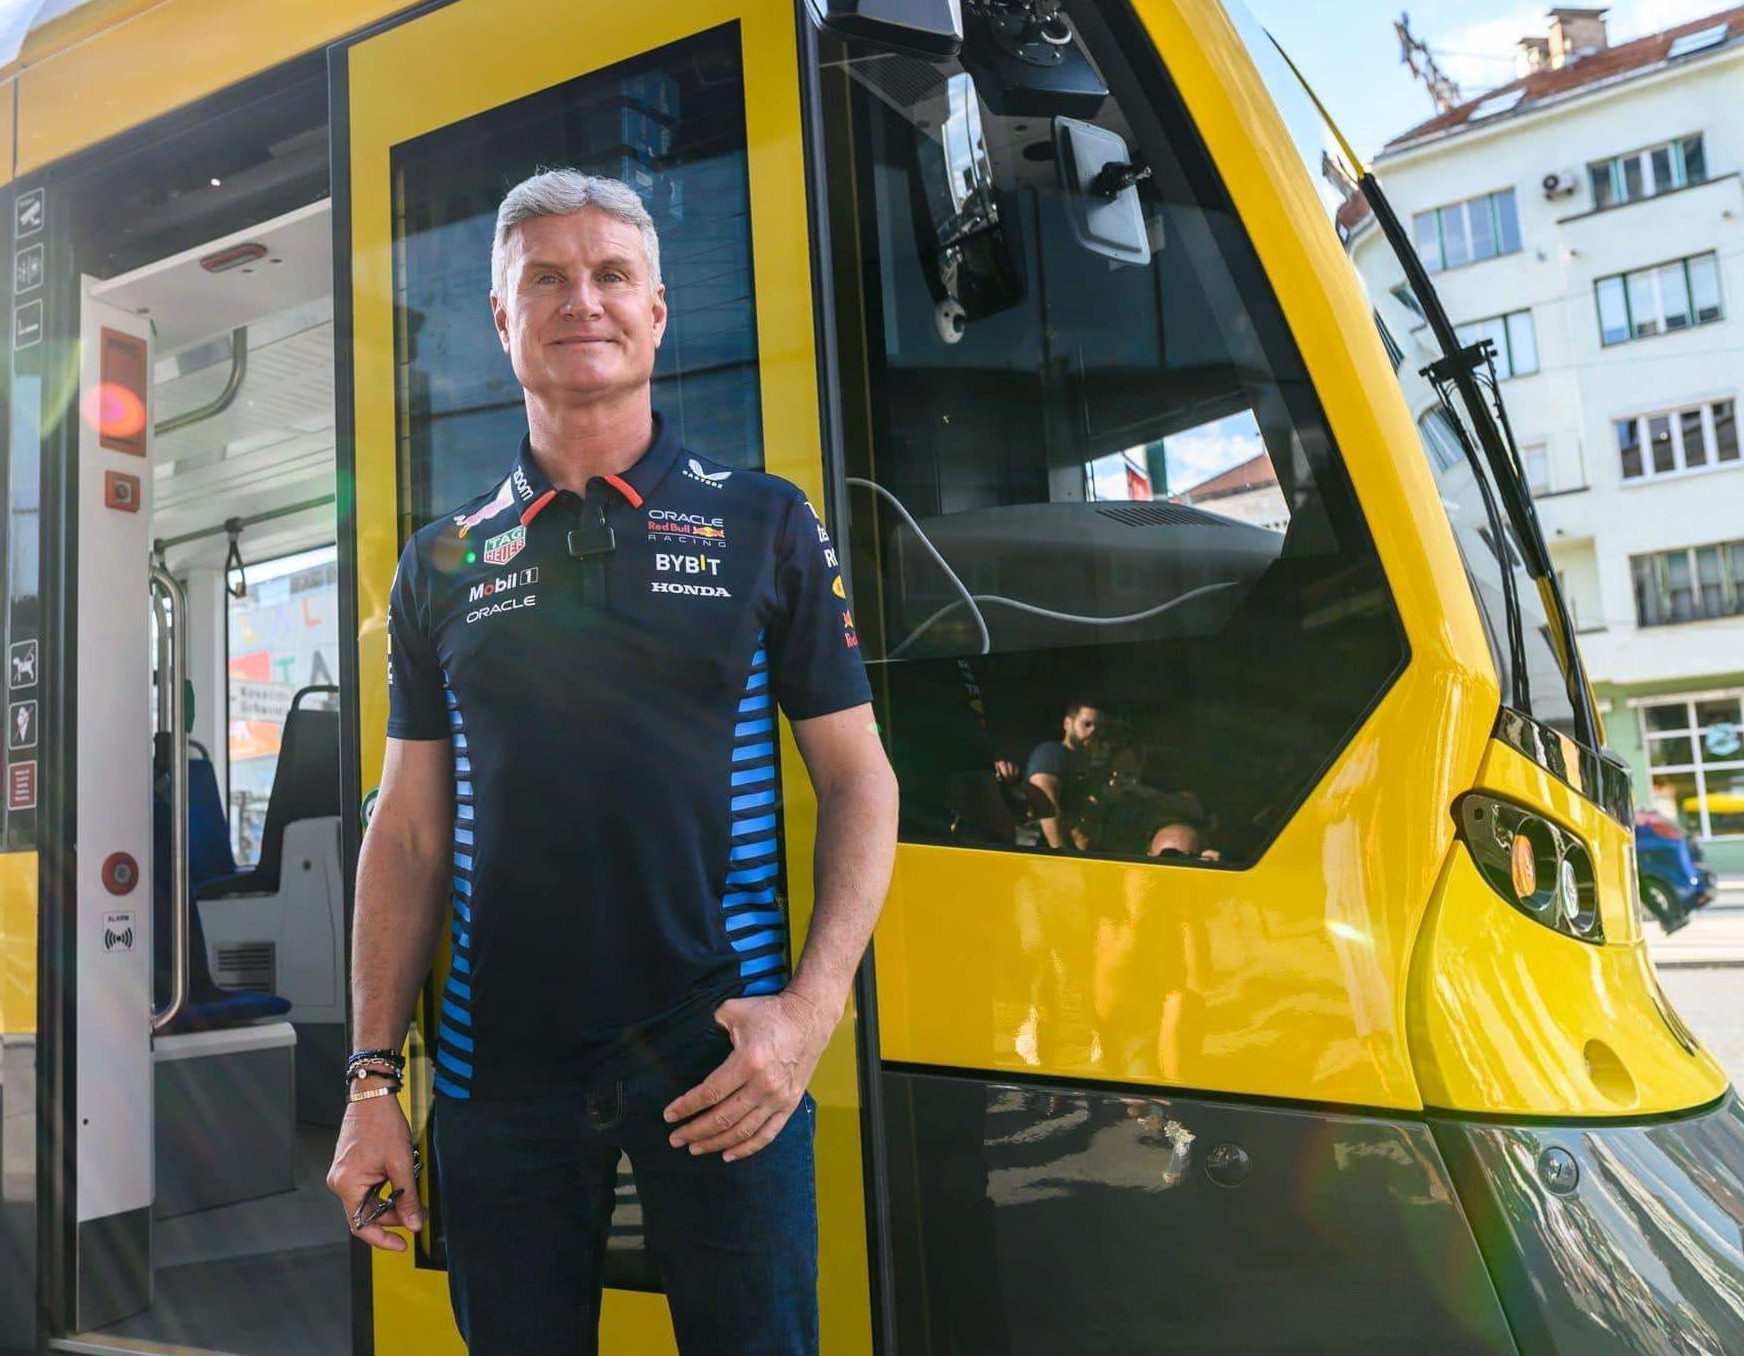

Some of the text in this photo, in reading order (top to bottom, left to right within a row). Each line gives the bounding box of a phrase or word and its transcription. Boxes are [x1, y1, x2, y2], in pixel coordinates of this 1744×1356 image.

[648, 509, 725, 528] ORACLE
[490, 527, 522, 549] TAG
[647, 534, 727, 548] RACING
[486, 540, 523, 563] HEUER
[655, 553, 721, 576] BYBIT
[468, 572, 518, 603] Mobil
[651, 582, 732, 598] HONDA
[466, 594, 536, 624] ORACLE
[107, 914, 130, 923] ALARM
